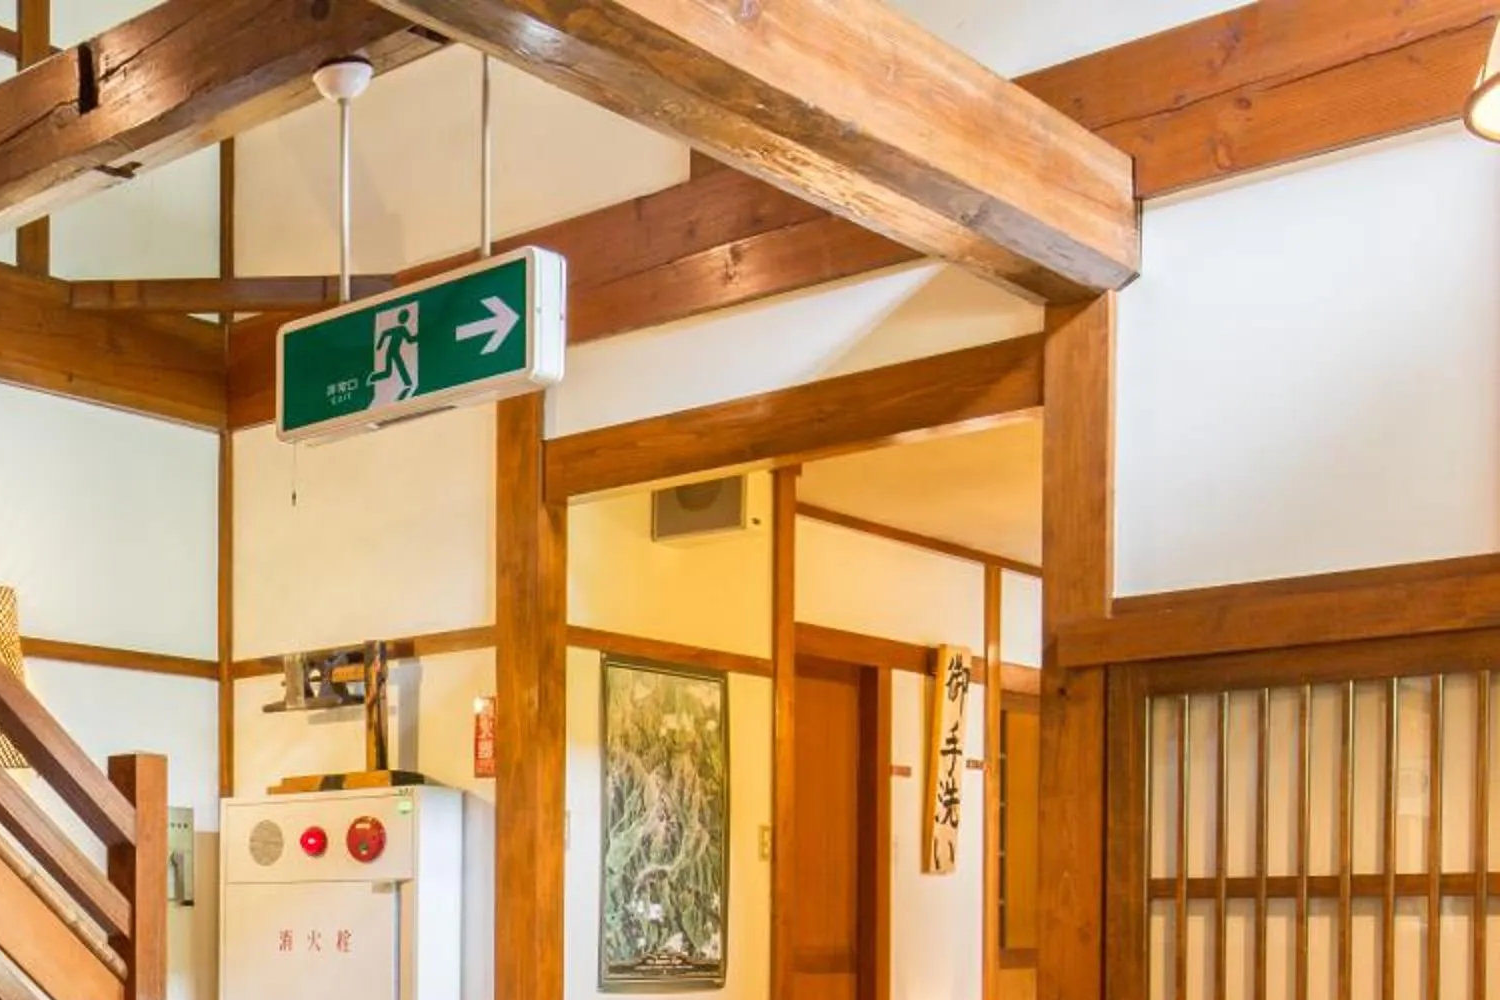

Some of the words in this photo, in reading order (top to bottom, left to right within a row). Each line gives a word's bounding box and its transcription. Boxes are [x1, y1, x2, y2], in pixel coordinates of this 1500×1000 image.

[933, 652, 972, 871] 御手洗い
[278, 929, 353, 953] 消火栓
